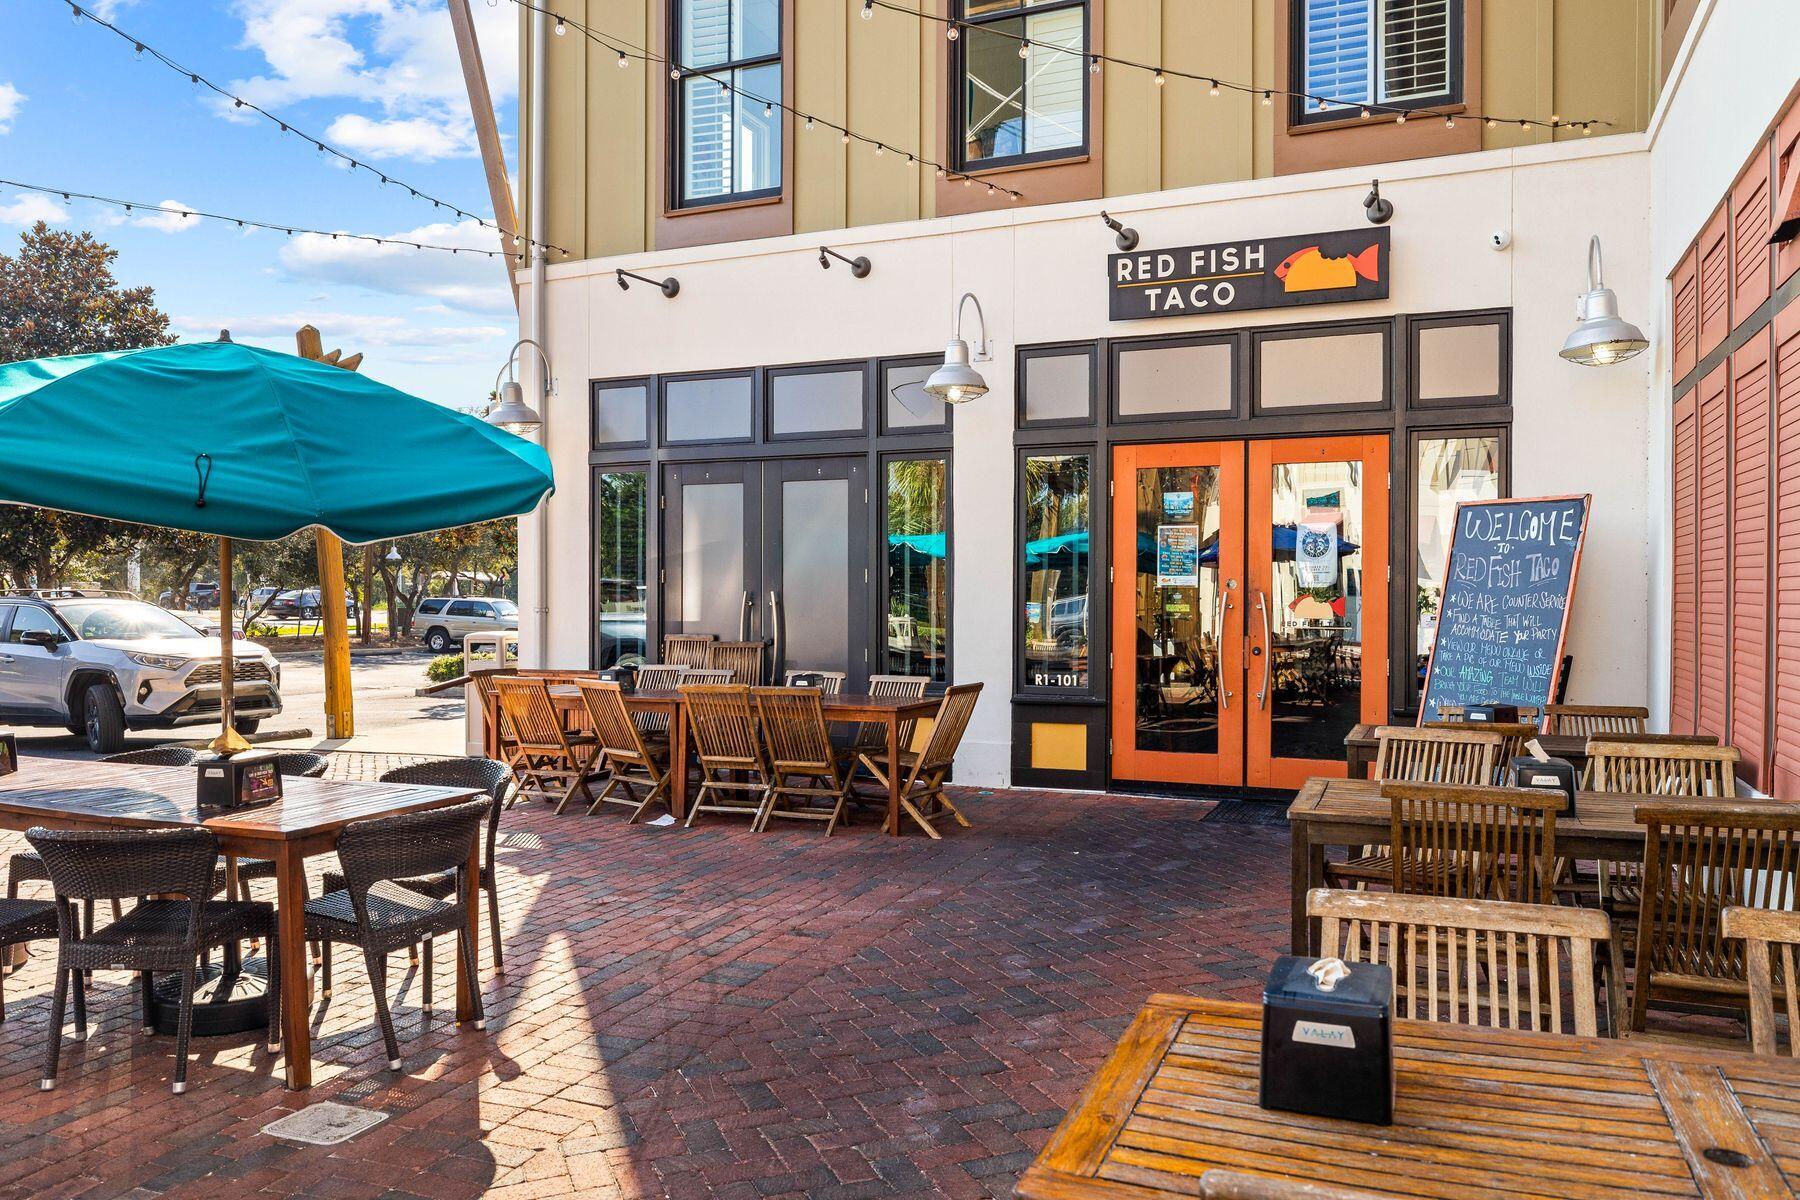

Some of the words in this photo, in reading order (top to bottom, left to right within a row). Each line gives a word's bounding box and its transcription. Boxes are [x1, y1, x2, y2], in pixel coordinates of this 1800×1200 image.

[1117, 254, 1176, 282] RED
[1190, 244, 1265, 275] FISH
[1144, 281, 1236, 312] TACO
[1465, 508, 1575, 546] WELCOME
[1453, 552, 1486, 581] RED
[1525, 553, 1560, 582] TACO
[1457, 591, 1475, 609] WE
[1476, 593, 1499, 614] ARE
[1502, 593, 1539, 610] COUNTER
[1472, 614, 1478, 624] A
[1504, 613, 1521, 628] THAT
[1531, 628, 1558, 641] PARTY
[1034, 671, 1079, 686] R1-101
